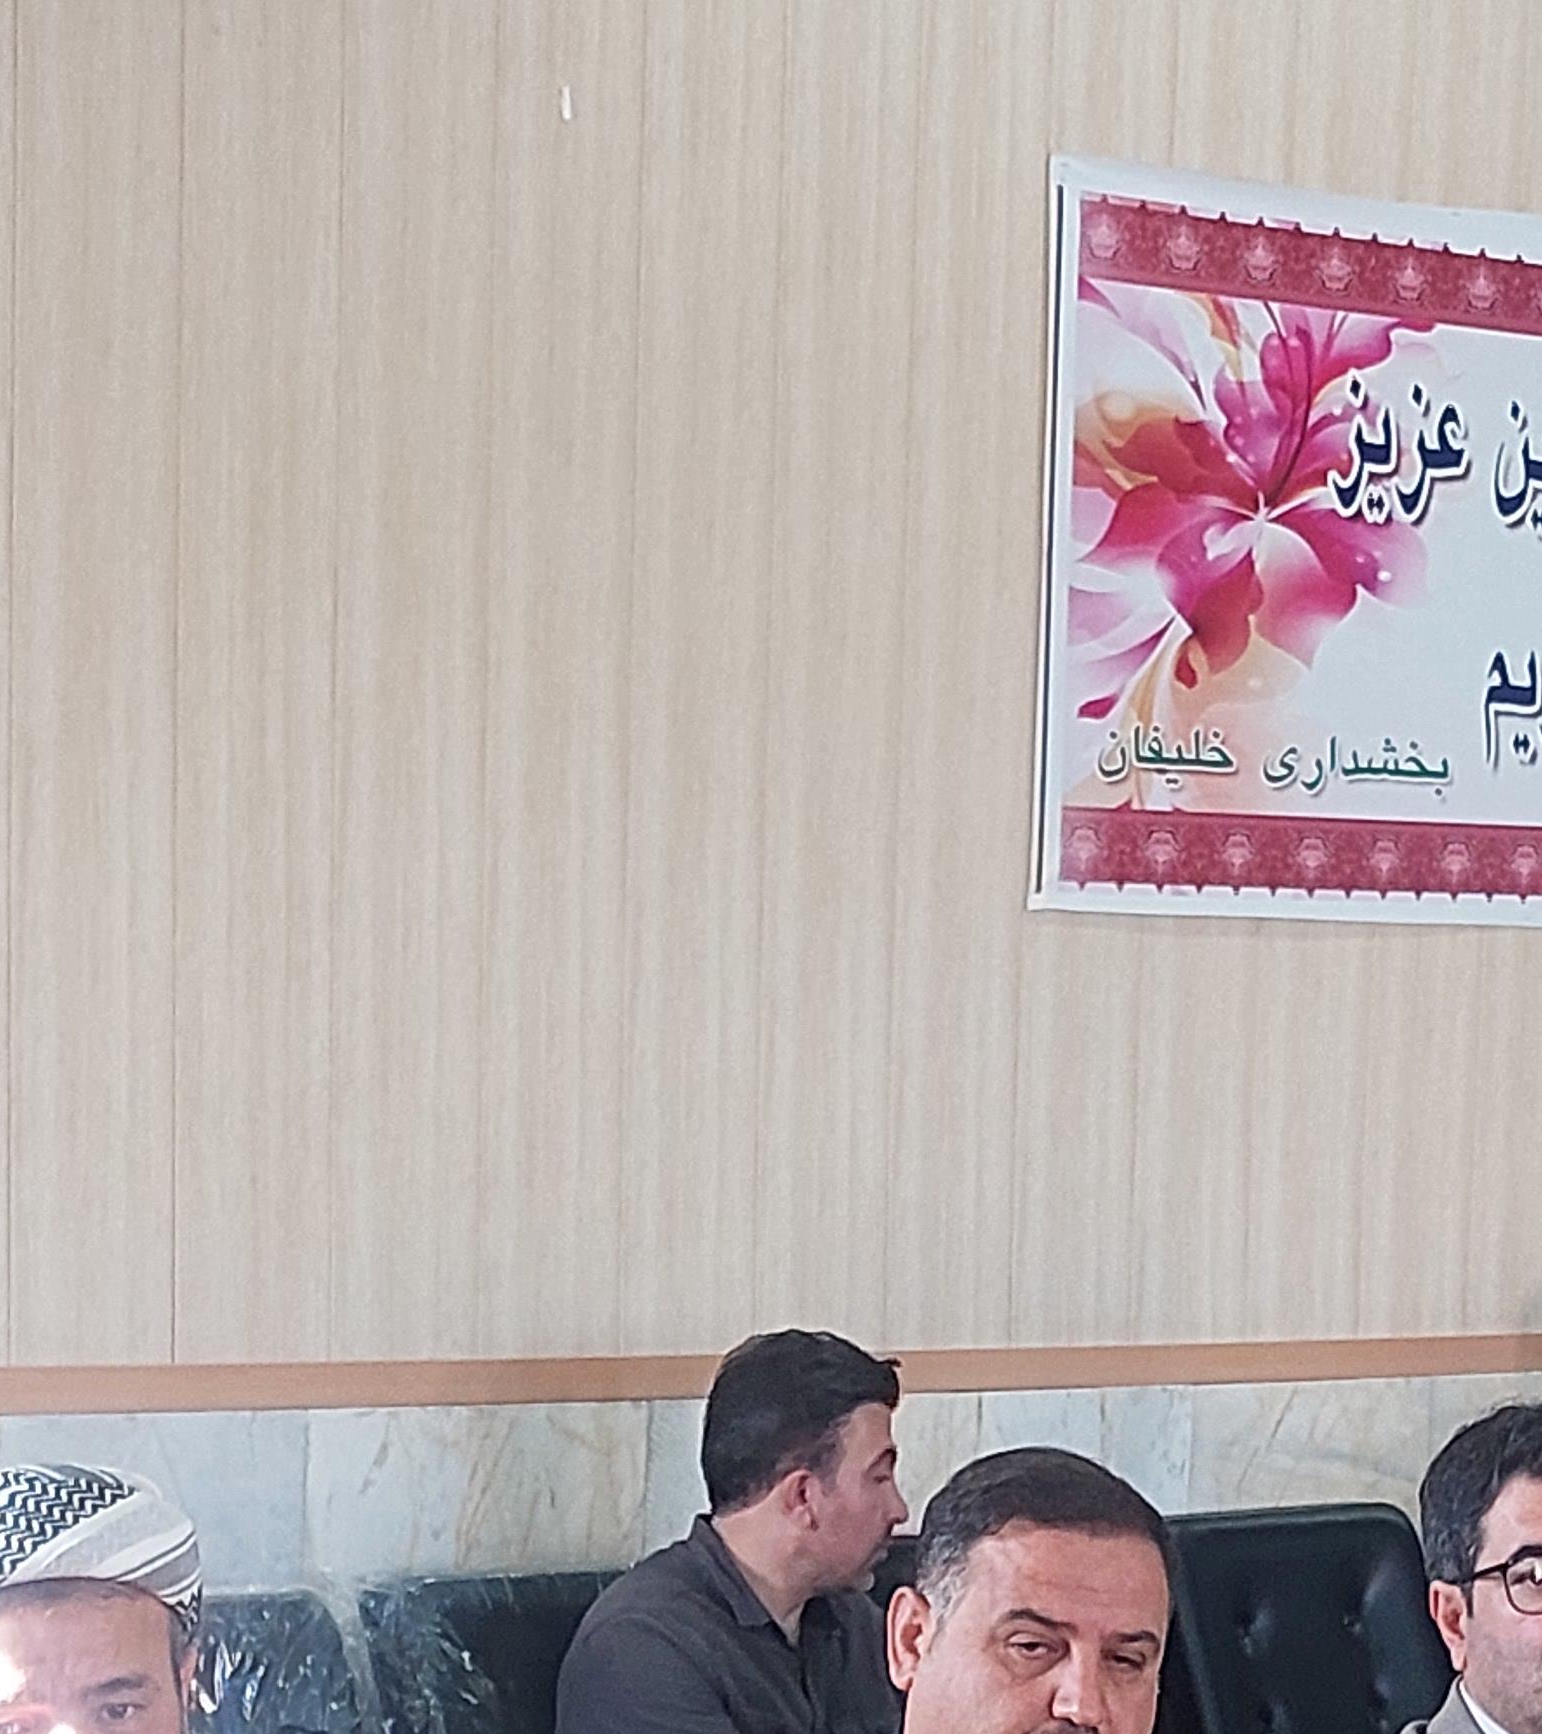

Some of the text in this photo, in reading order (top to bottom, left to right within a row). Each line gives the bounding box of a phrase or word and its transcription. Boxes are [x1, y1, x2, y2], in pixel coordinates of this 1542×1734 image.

[1329, 370, 1471, 522] عزیز
[1096, 723, 1450, 796] بخشداری خلیفان
